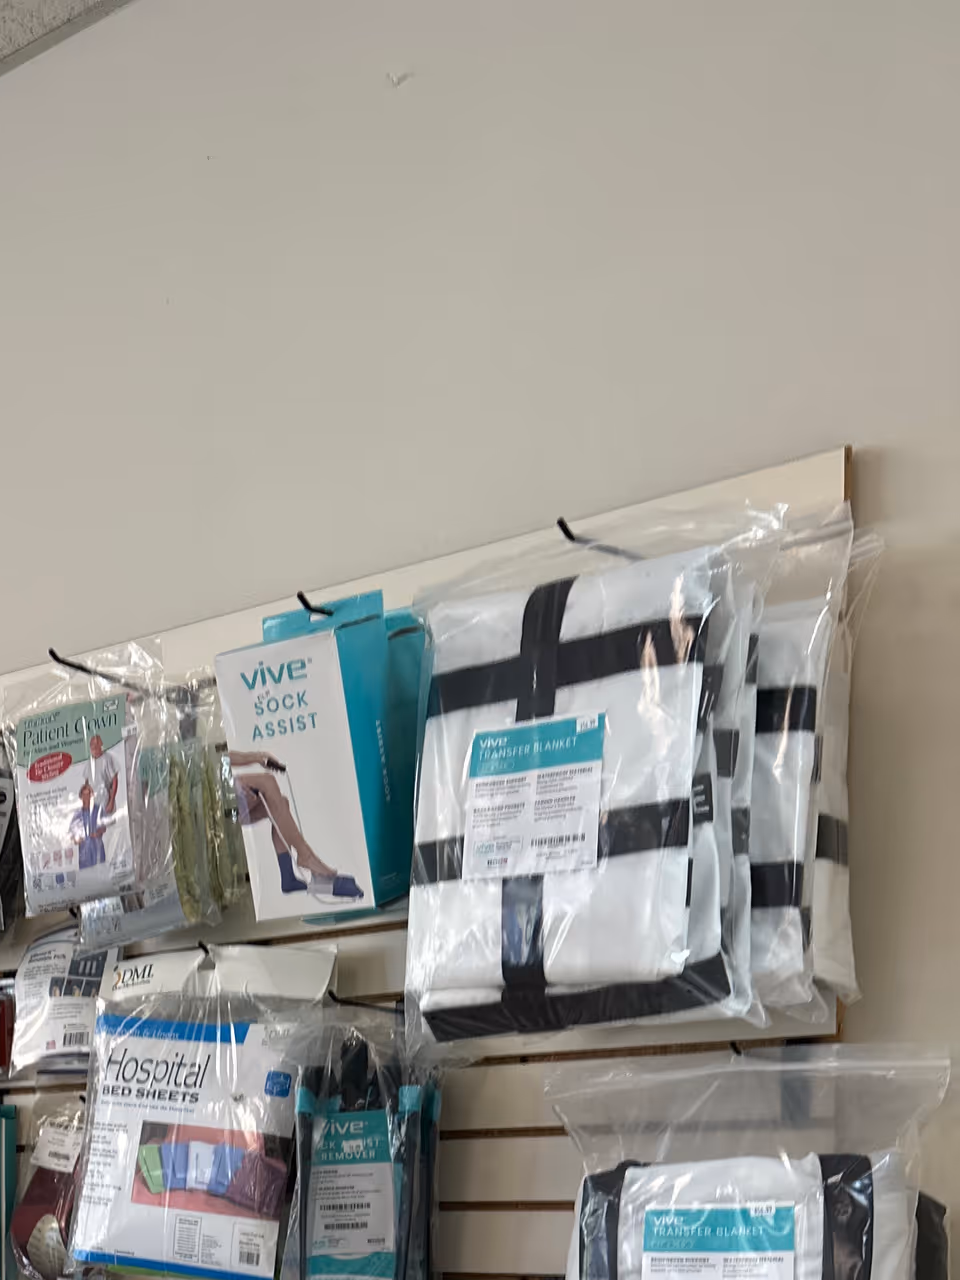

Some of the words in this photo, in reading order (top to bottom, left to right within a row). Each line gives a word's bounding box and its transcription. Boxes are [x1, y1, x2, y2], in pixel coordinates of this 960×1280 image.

[240, 659, 307, 690] vive
[255, 690, 308, 716] SOCK
[23, 722, 69, 747] Patient
[74, 713, 117, 734] Gown
[253, 712, 317, 742] ASSIST
[480, 743, 529, 761] TRANSFER
[534, 736, 577, 751] BLANKET
[122, 964, 154, 984] DMI
[105, 1048, 211, 1089] Hospital
[102, 1085, 132, 1097] BED
[135, 1088, 200, 1104] SHEETS
[322, 1151, 376, 1160] REMOVER
[654, 1216, 683, 1226] vive
[654, 1226, 711, 1238] TRANSFER
[717, 1225, 763, 1236] BLANKET
